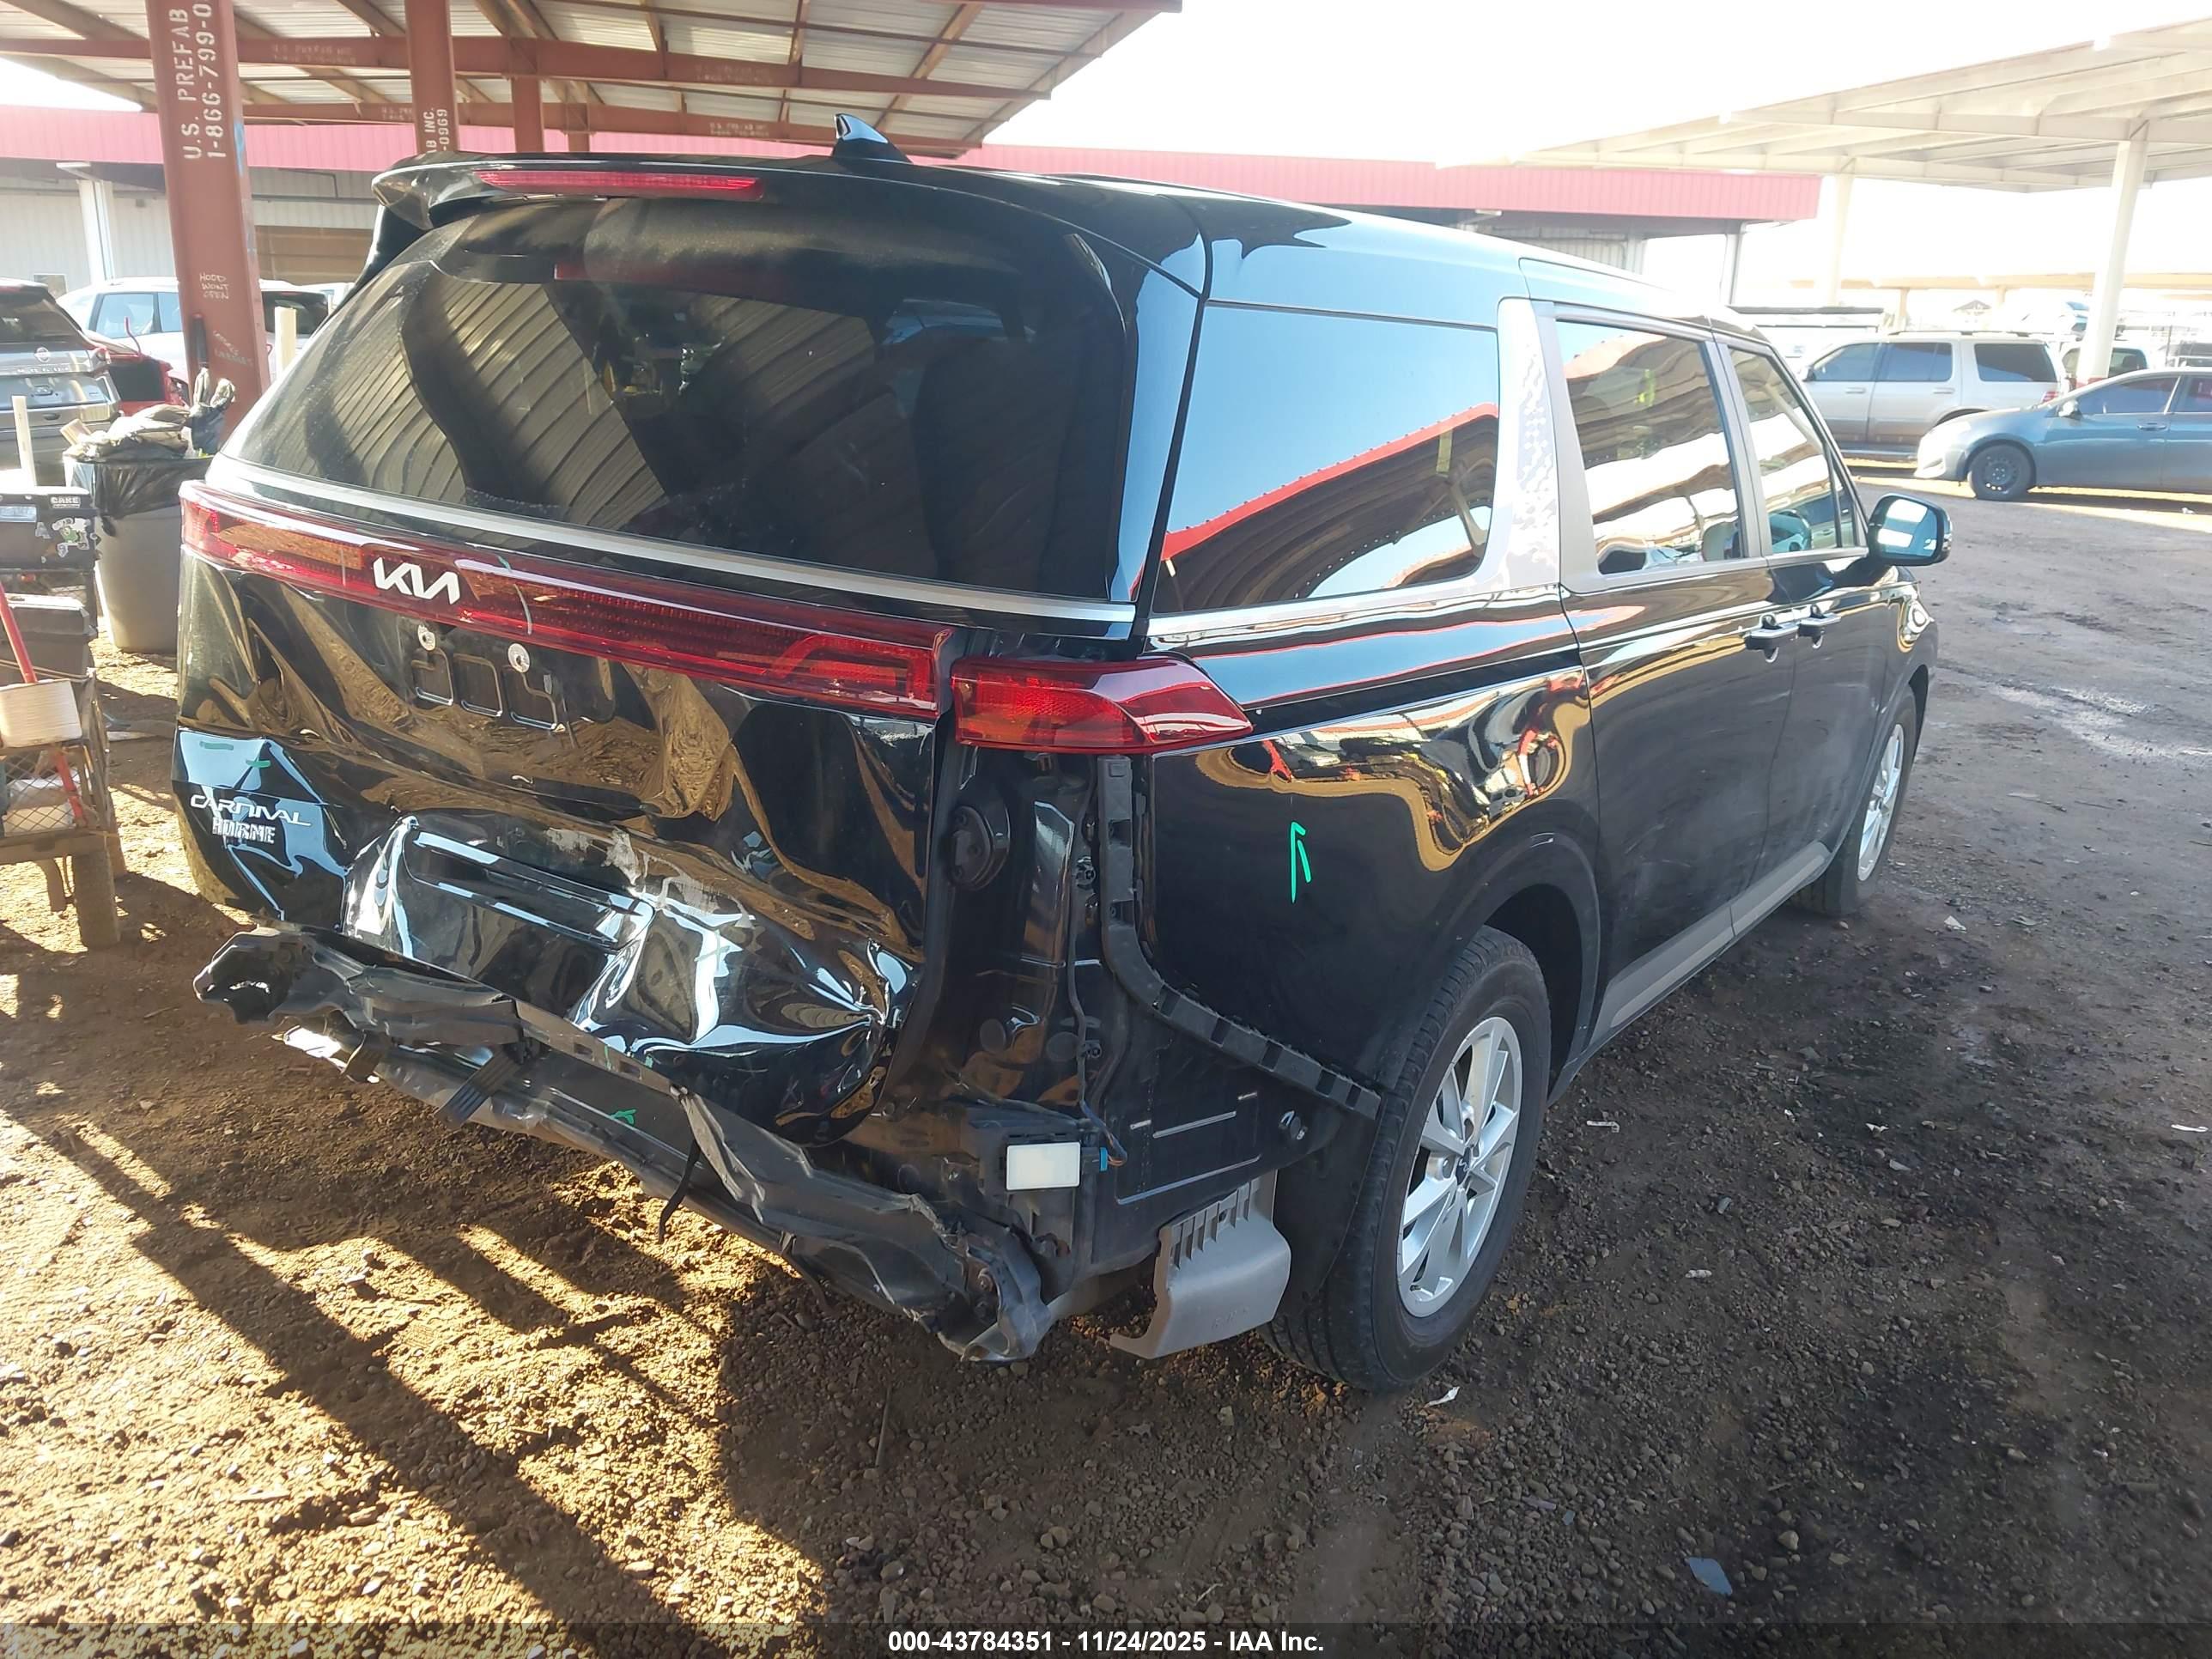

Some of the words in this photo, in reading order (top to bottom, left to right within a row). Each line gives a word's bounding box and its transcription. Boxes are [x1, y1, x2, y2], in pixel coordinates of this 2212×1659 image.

[168, 9, 197, 101] PREFAB
[181, 115, 203, 160] U.S.
[422, 107, 436, 132] INC.
[199, 272, 227, 283] HOOD
[373, 556, 460, 605] KIA
[190, 794, 312, 827] CARNIVAL
